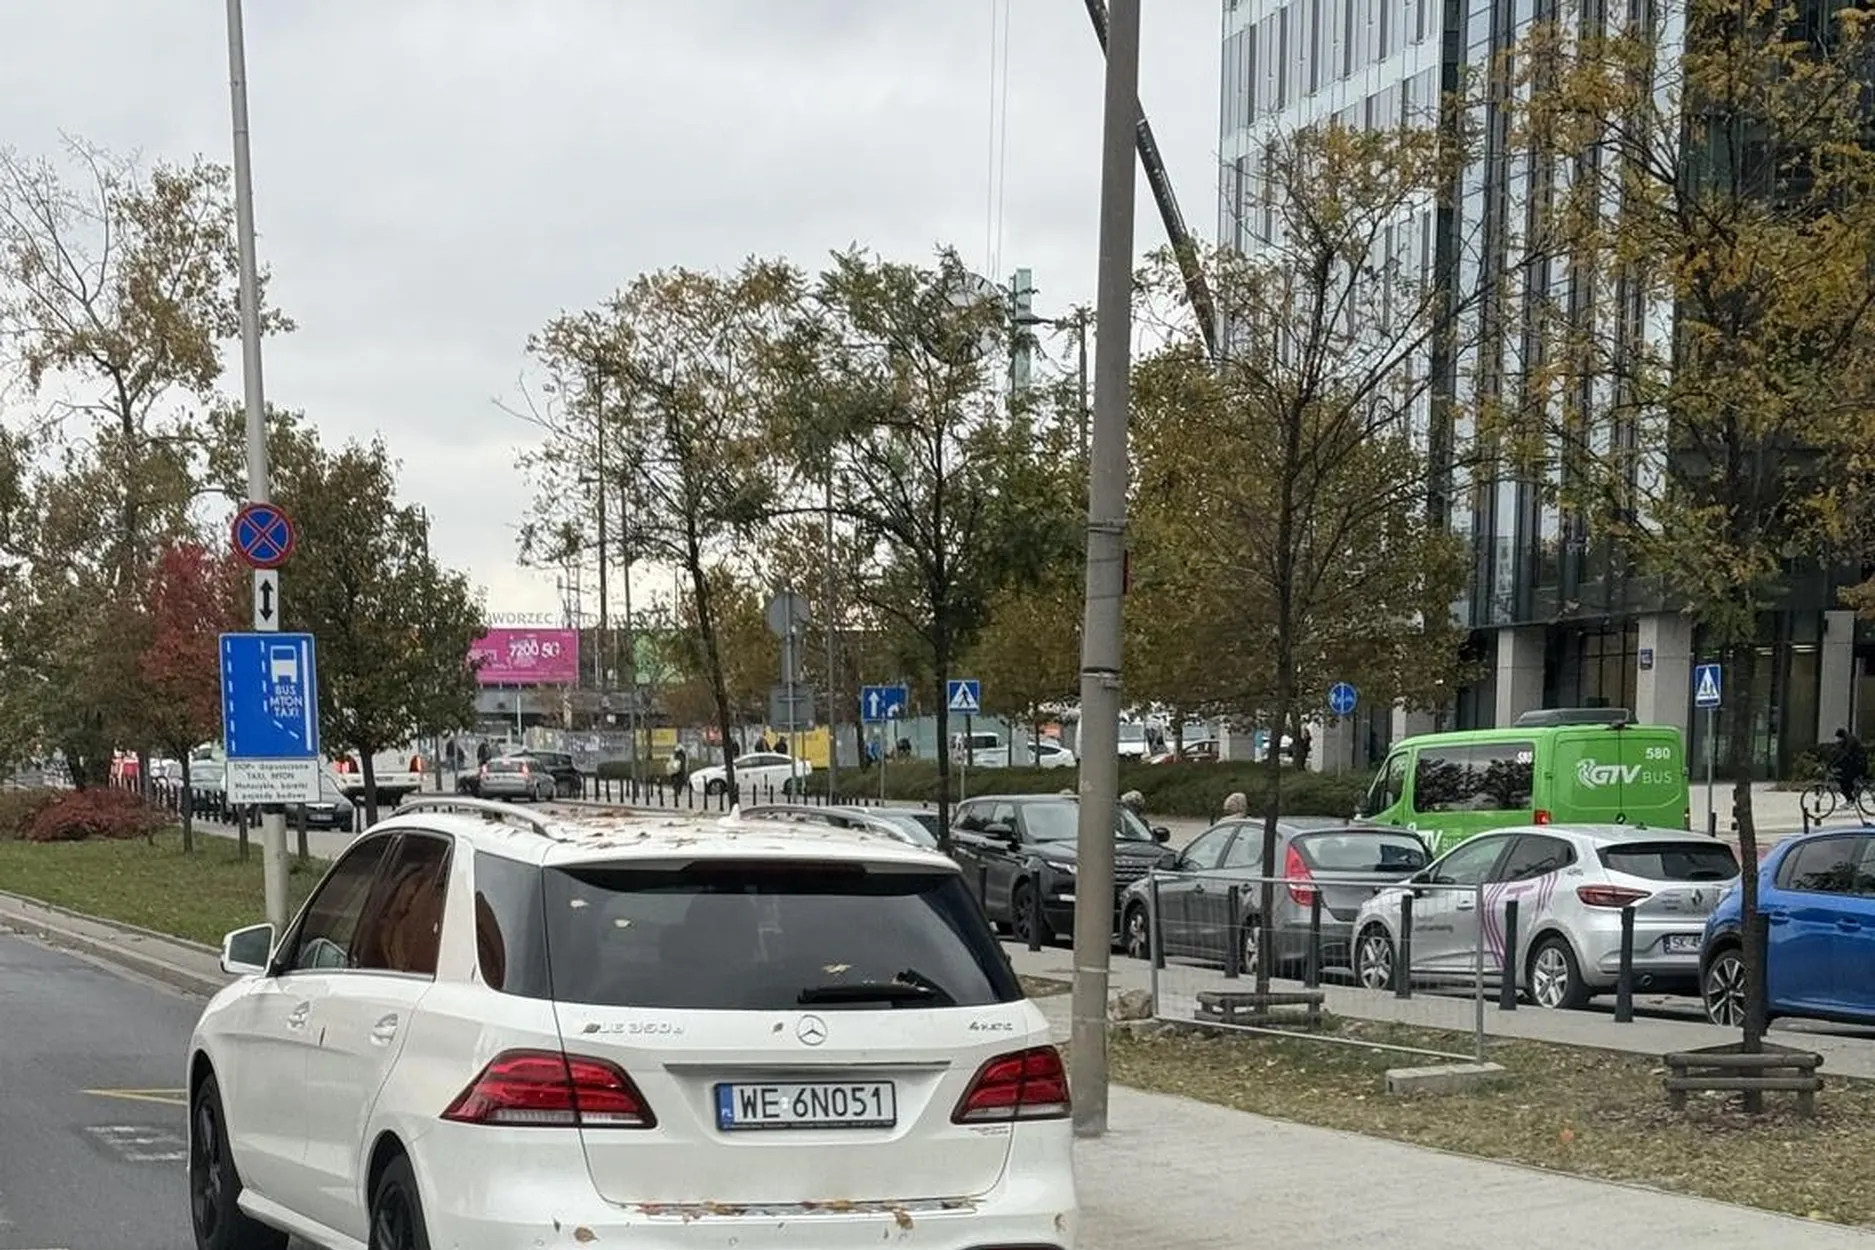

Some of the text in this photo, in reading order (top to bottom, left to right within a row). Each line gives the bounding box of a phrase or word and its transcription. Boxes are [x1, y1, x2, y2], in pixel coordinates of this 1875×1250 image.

[275, 684, 297, 695] BUS
[270, 695, 303, 708] MTON
[274, 707, 299, 719] TAXI
[1645, 747, 1671, 760] 580
[1590, 764, 1672, 785] GTV BUS
[583, 1021, 624, 1034] LE
[740, 1086, 882, 1119] WE 6N051
